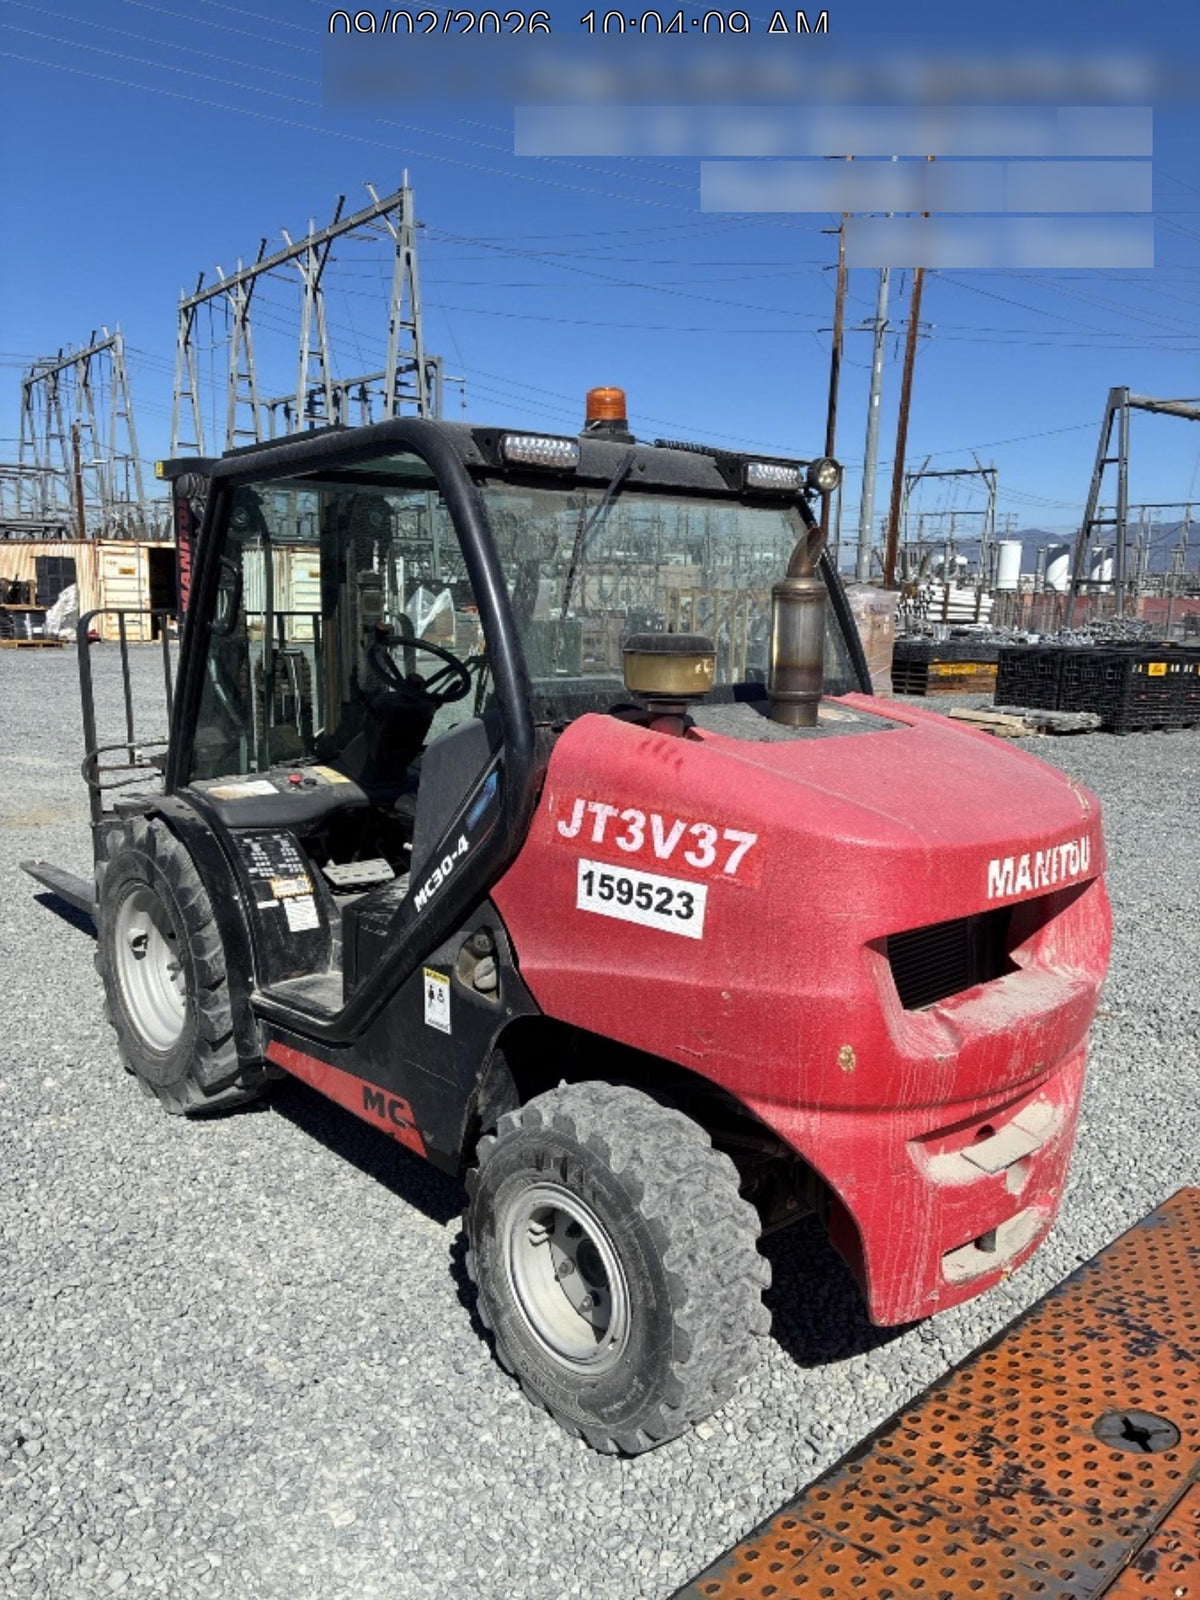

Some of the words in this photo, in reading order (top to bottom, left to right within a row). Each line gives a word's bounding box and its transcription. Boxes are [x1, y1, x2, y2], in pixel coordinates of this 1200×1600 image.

[557, 798, 758, 875] JT3V37
[987, 835, 1091, 899] MANITOU
[413, 833, 470, 913] MC30-4
[582, 870, 694, 920] 159523
[362, 1085, 405, 1129] MC
